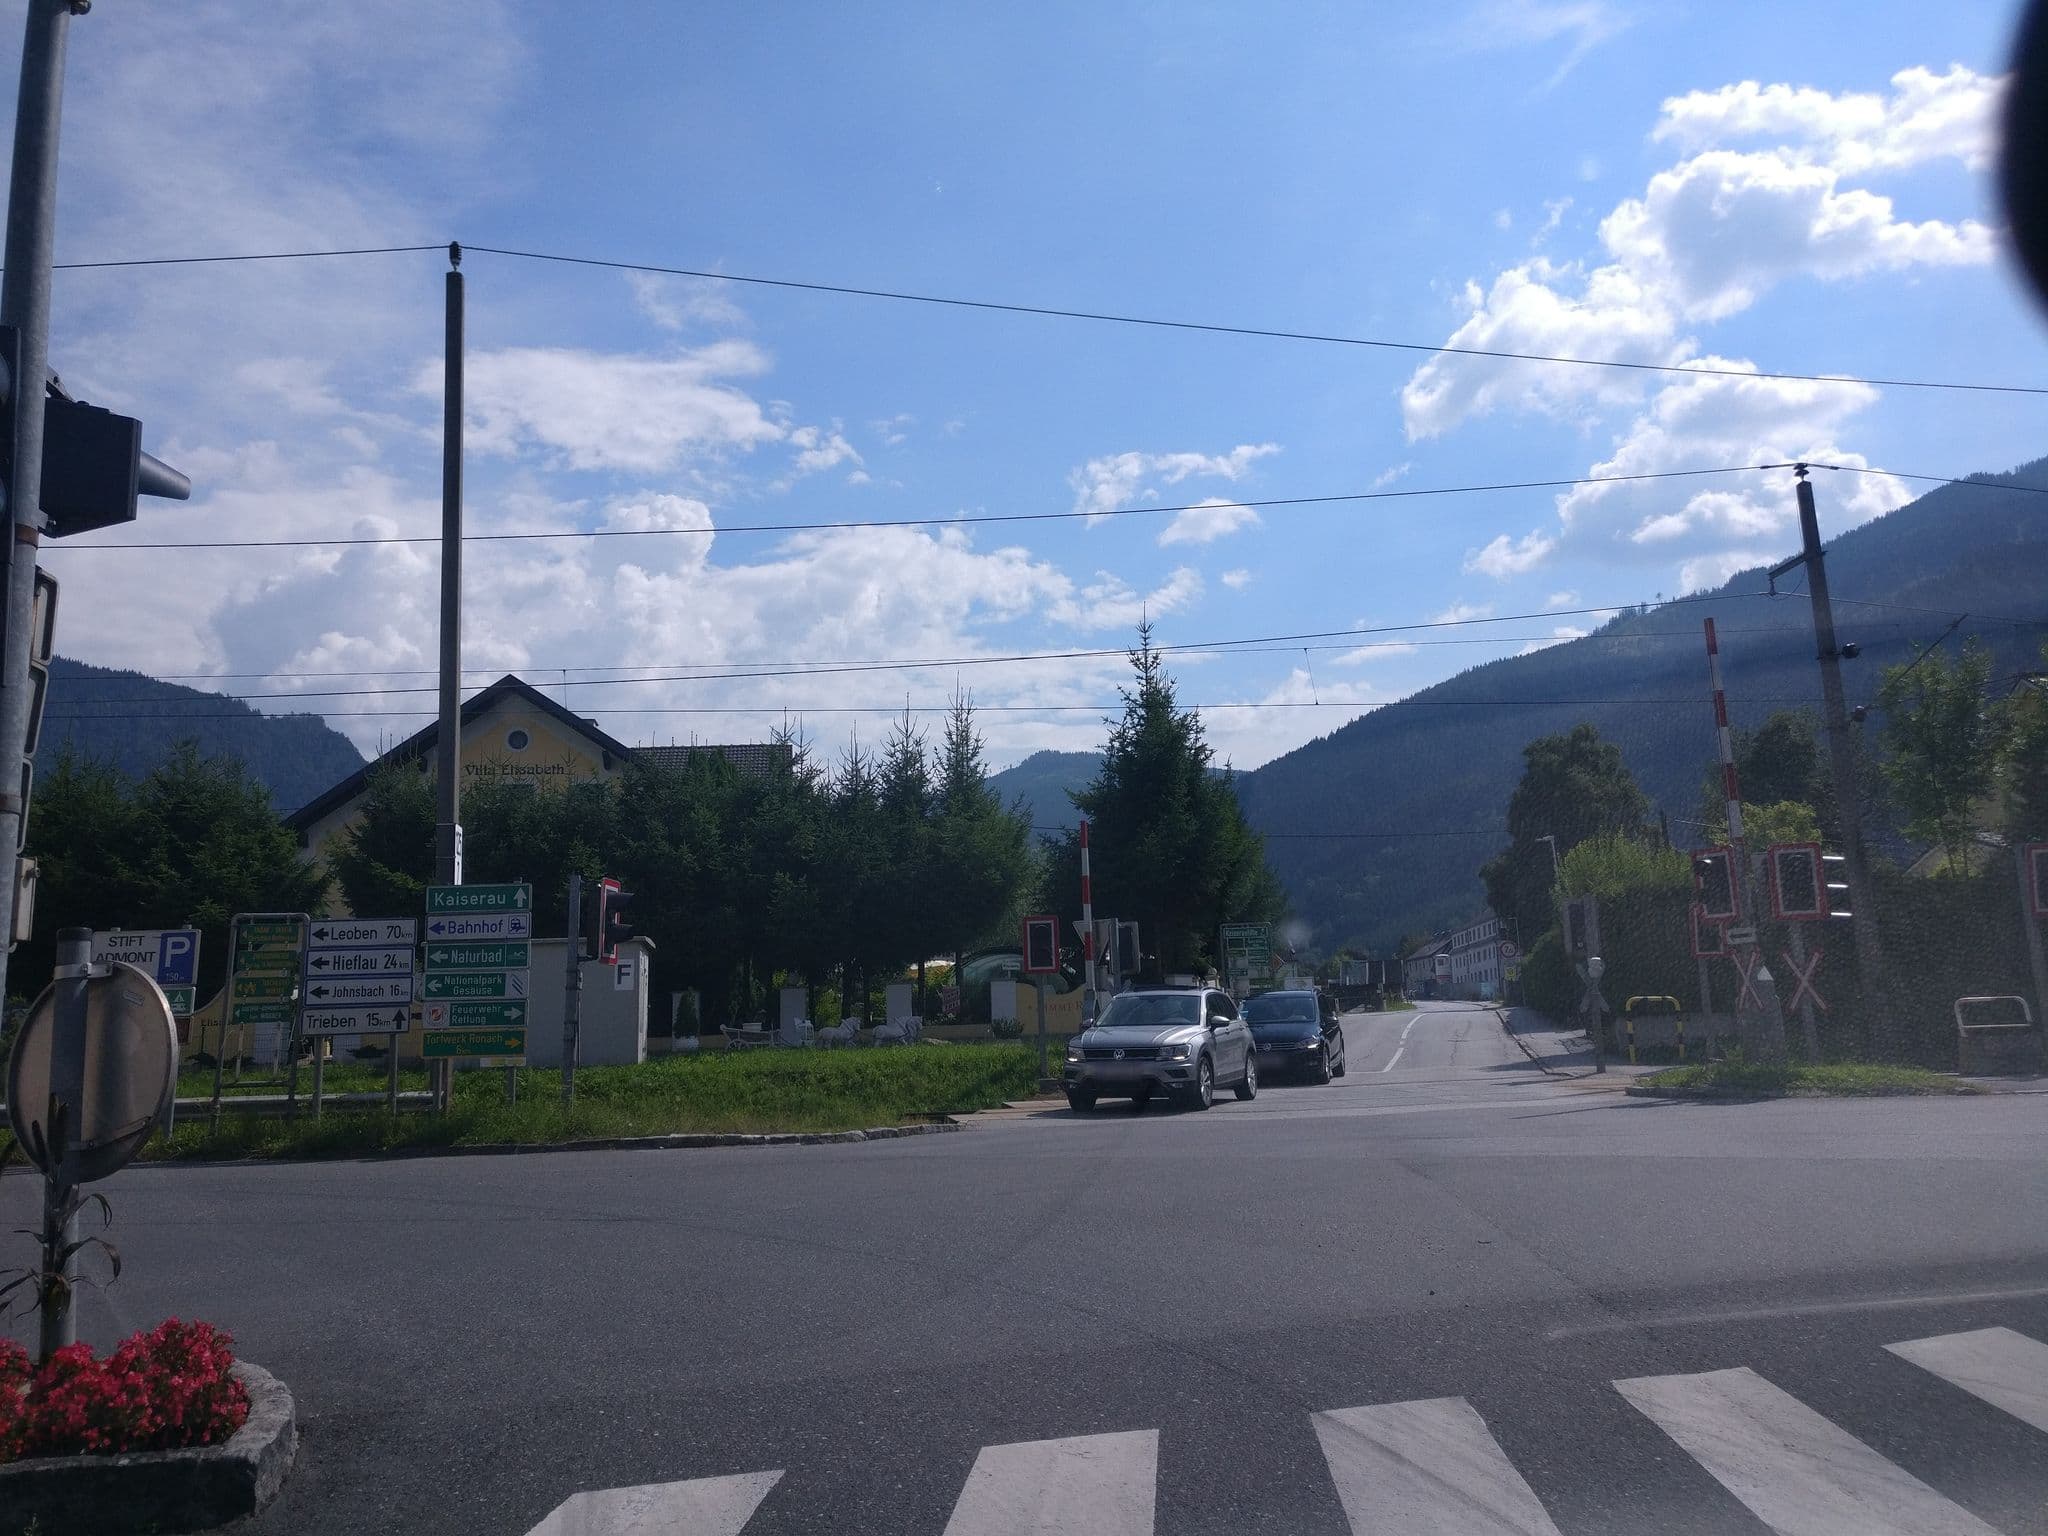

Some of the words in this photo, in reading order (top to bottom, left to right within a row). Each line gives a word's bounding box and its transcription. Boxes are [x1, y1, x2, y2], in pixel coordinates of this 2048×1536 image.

[434, 892, 506, 906] Kaiserau
[331, 926, 377, 940] Leoben
[448, 920, 504, 934] Bahnhof
[108, 936, 145, 947] STIFT
[96, 951, 157, 963] ADMONT
[165, 936, 191, 968] P
[451, 948, 503, 964] Naturbad
[333, 955, 377, 971] Hieflau
[444, 975, 503, 985] Nationalpark
[617, 964, 632, 985] F
[332, 985, 385, 998] Johnsbach
[451, 1005, 502, 1014] Feuerwehr
[306, 1014, 356, 1028] Trieben
[451, 1015, 487, 1025] Rettung
